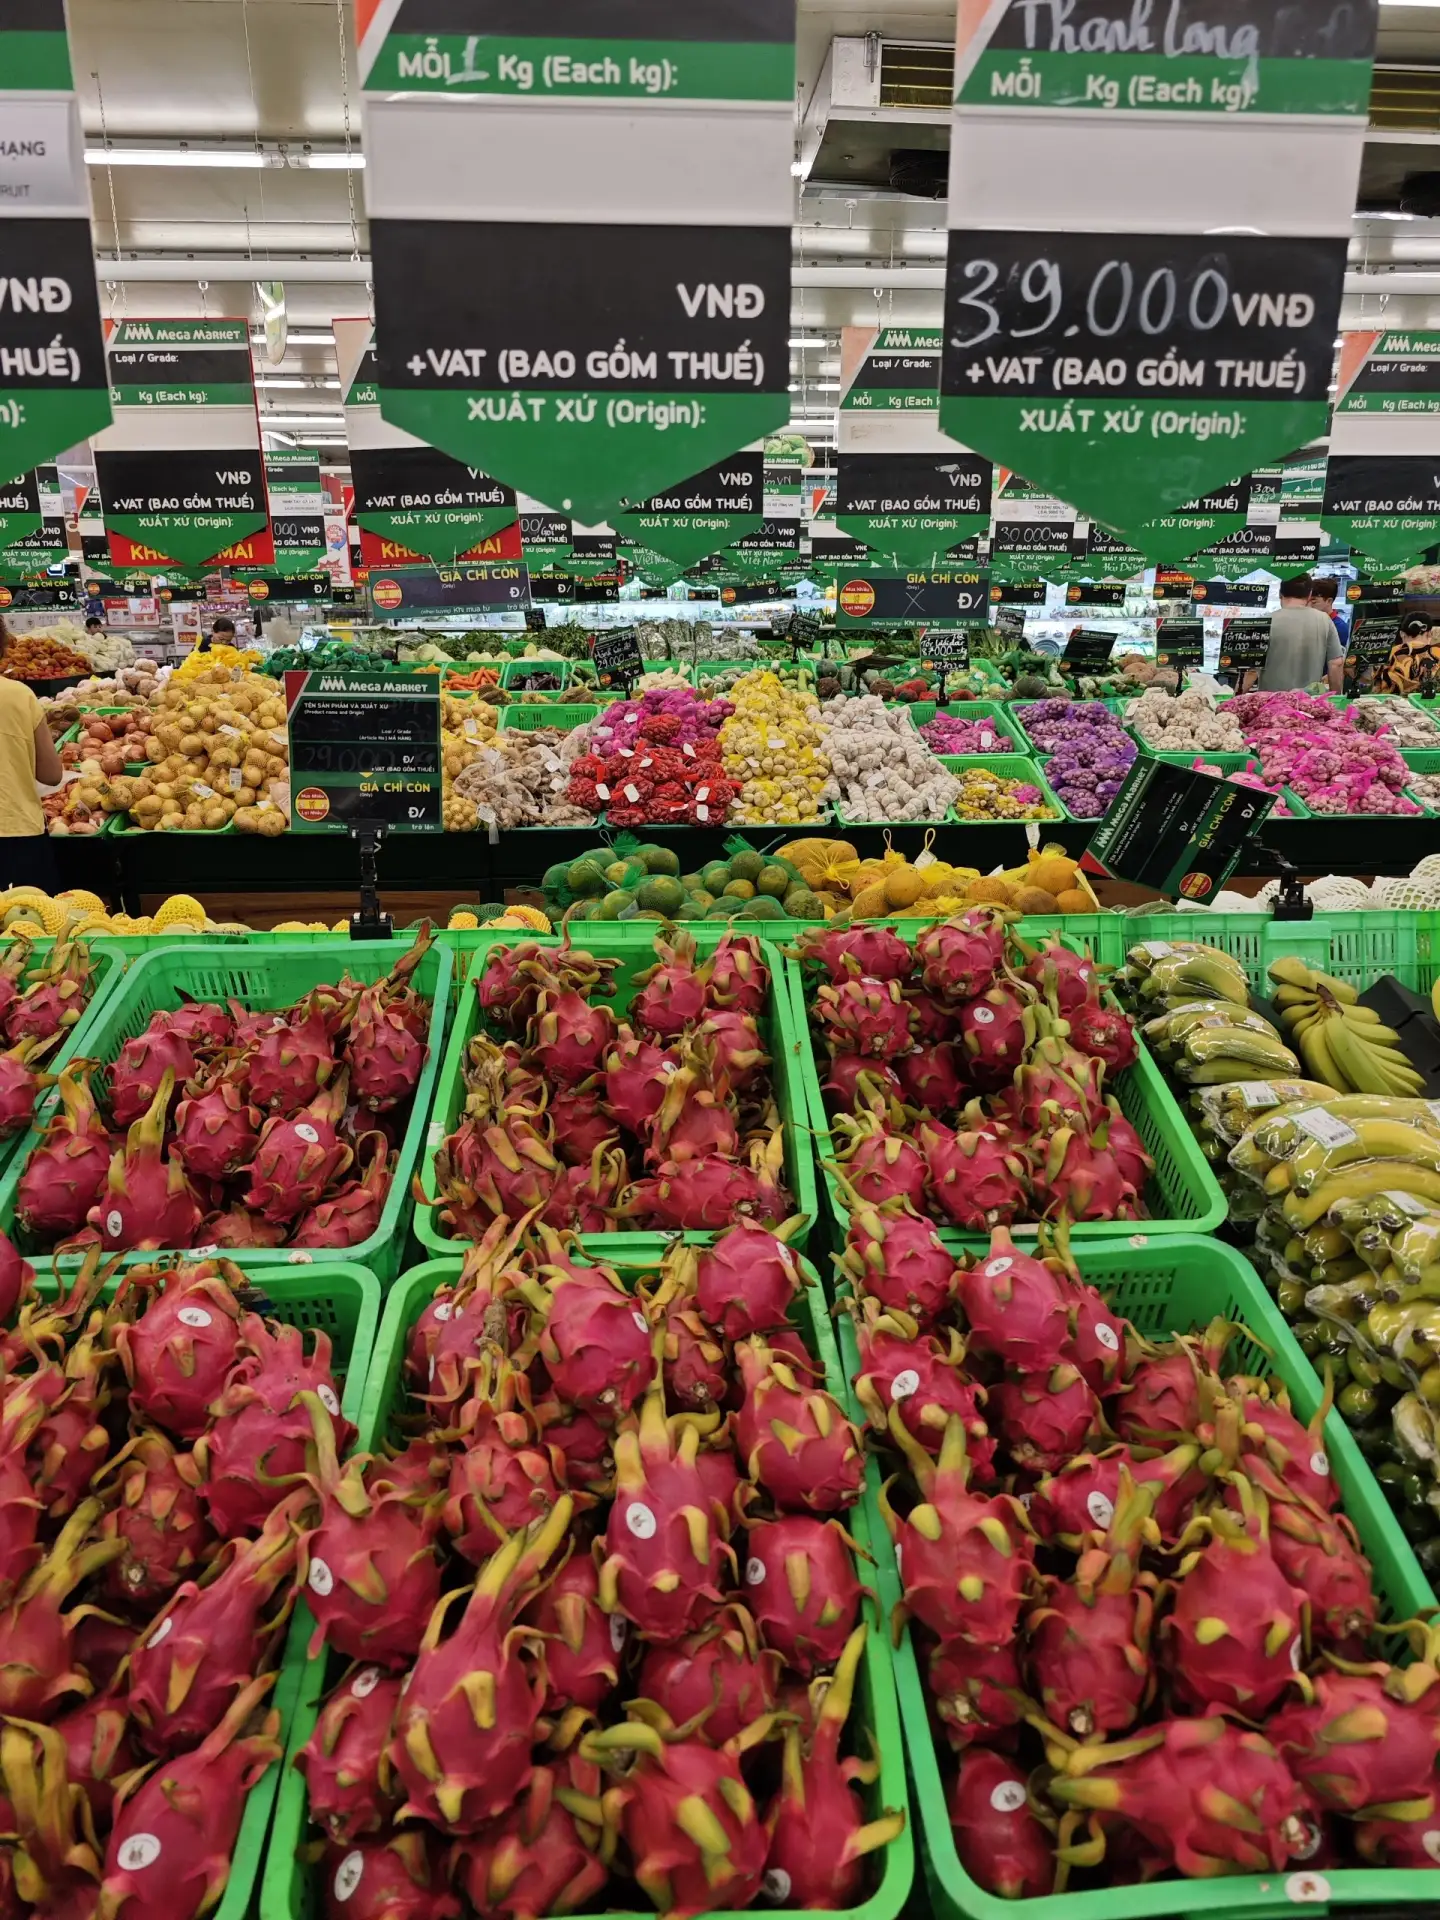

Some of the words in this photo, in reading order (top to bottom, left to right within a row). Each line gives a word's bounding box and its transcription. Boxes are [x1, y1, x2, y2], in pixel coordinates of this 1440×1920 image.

[398, 38, 450, 79] MỖI
[497, 54, 534, 88] Kg
[542, 54, 621, 87] (Each
[629, 58, 679, 93] kg):
[990, 59, 1041, 98] MỖI
[1086, 74, 1119, 109] Kg
[1129, 75, 1203, 107] (Each
[676, 283, 765, 319] VNĐ
[950, 259, 1229, 349] 39.000
[1231, 293, 1315, 328] VNĐ
[147, 353, 179, 364] Grade:
[407, 349, 486, 378] +VAT
[498, 350, 577, 383] (BAO
[668, 340, 765, 385] THUẾ)
[902, 359, 932, 368] Grade:
[966, 357, 1043, 385] +VAT
[1052, 358, 1127, 390] (BAO
[1216, 349, 1307, 393] THUẾ)
[1400, 363, 1428, 373] Grade:
[139, 391, 153, 403] Kg
[155, 390, 186, 402] (Each
[189, 391, 208, 403] kg):
[888, 396, 902, 408] Kg
[904, 396, 933, 407] (Each
[1382, 400, 1395, 411] Kg
[1397, 399, 1425, 411] (Each
[555, 394, 598, 423] XỨ
[606, 399, 706, 431] (Origin):
[1103, 404, 1144, 433] XỨ
[1151, 410, 1246, 441] (Origin):
[216, 471, 252, 486] VNĐ
[719, 472, 753, 486] VNĐ
[949, 474, 982, 487] VNĐ
[112, 498, 145, 510] +VAT
[148, 498, 180, 511] (BAO
[218, 492, 254, 510] THUẾ)
[366, 496, 396, 508] +VAT
[400, 494, 430, 508] (BAO
[466, 486, 505, 505] THUẾ)
[651, 498, 681, 511] (BAO
[716, 494, 753, 512] THUẾ)
[846, 499, 877, 512] +VAT
[880, 499, 910, 512] (BAO
[946, 494, 981, 512] THUẾ)
[1203, 494, 1238, 512] THUẾ)
[1332, 501, 1362, 511] +VAT
[1364, 501, 1393, 513] (BAO
[173, 516, 190, 528] XỨ
[194, 517, 234, 529] (Origin):
[424, 510, 441, 524] XỨ
[444, 511, 484, 524] (Origin):
[672, 515, 689, 528] XỨ
[692, 517, 731, 530] (Origin):
[902, 517, 918, 529] XỨ
[920, 518, 959, 530] (Origin):
[1160, 516, 1176, 528] XỨ
[1178, 517, 1216, 530] (Origin):
[301, 526, 320, 534] VNĐ
[1382, 518, 1399, 529] XỨ
[1401, 520, 1438, 531] (Origin):
[778, 528, 796, 536] VNĐ
[1052, 532, 1068, 540] VNĐ
[1016, 544, 1032, 552] (BAO
[440, 570, 462, 583] GIÁ
[492, 564, 520, 580] CÒN
[906, 570, 926, 584] GIÁ
[954, 571, 979, 584] CÒN
[359, 781, 379, 792] GIÁ
[406, 780, 431, 792] CÒN
[1198, 831, 1212, 848] GIÁ
